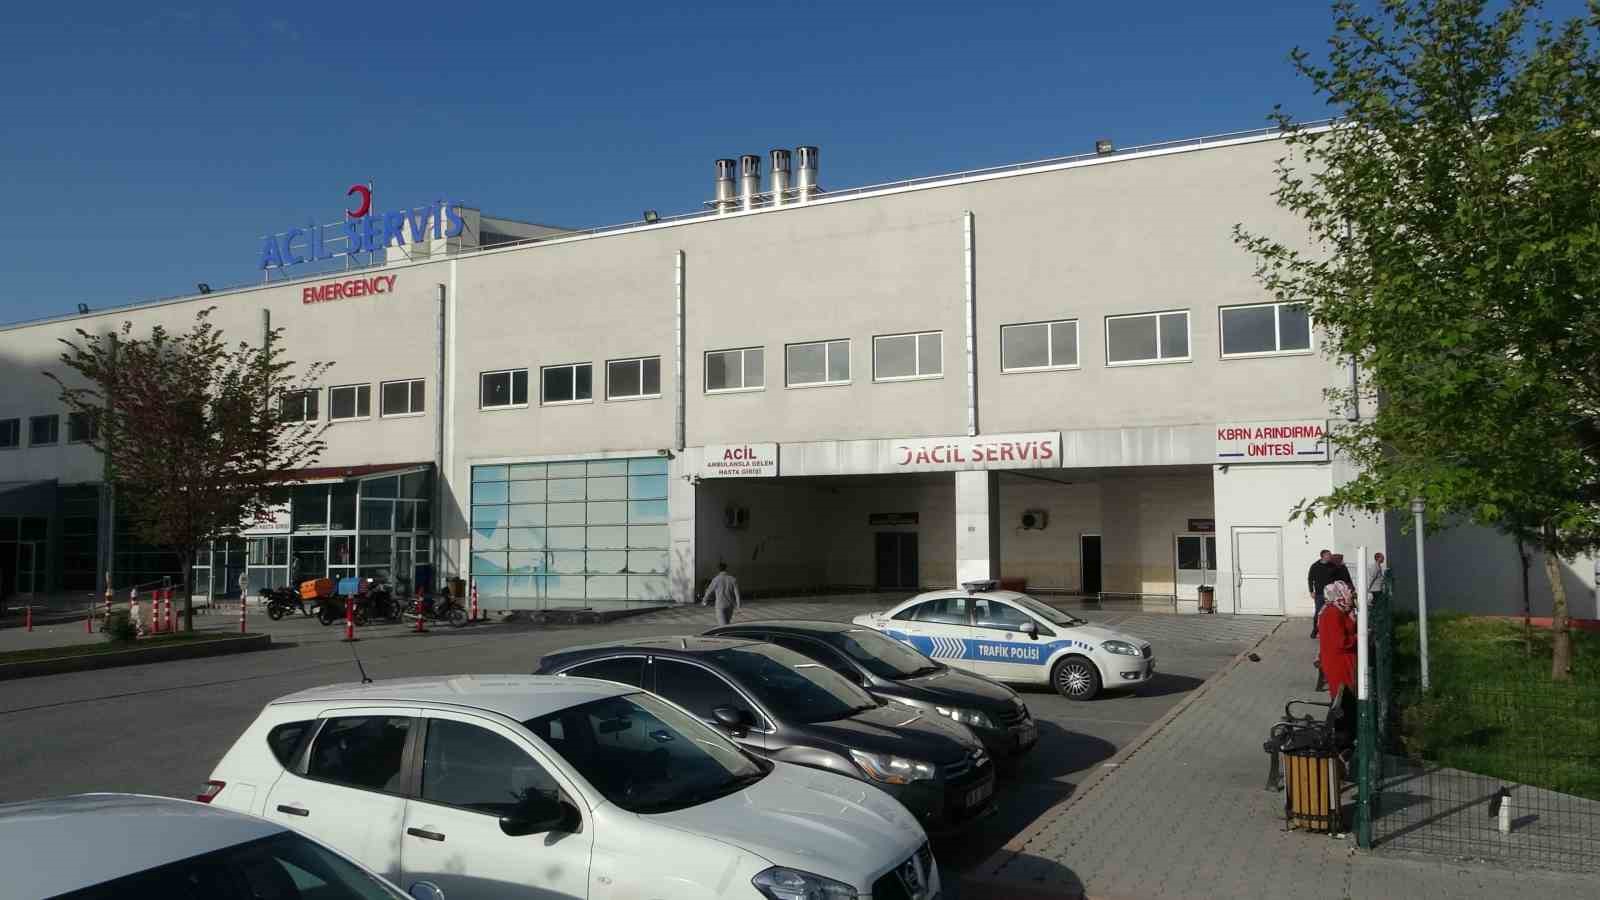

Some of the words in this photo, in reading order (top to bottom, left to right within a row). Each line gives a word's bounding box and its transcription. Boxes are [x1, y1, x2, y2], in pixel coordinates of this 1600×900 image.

[260, 217, 333, 269] ACİL
[343, 192, 464, 256] SERVİS
[303, 275, 397, 304] EMERGENCY
[1217, 428, 1252, 441] KBRN
[1254, 426, 1323, 440] ARINDIRMA
[723, 445, 757, 460] ACİL
[916, 444, 966, 465] ACİL
[972, 440, 1054, 462] SERVİS
[1247, 442, 1294, 457] ÜNİTESİ
[978, 643, 1009, 657] TRAFİK
[1010, 646, 1040, 660] POLİSİ
